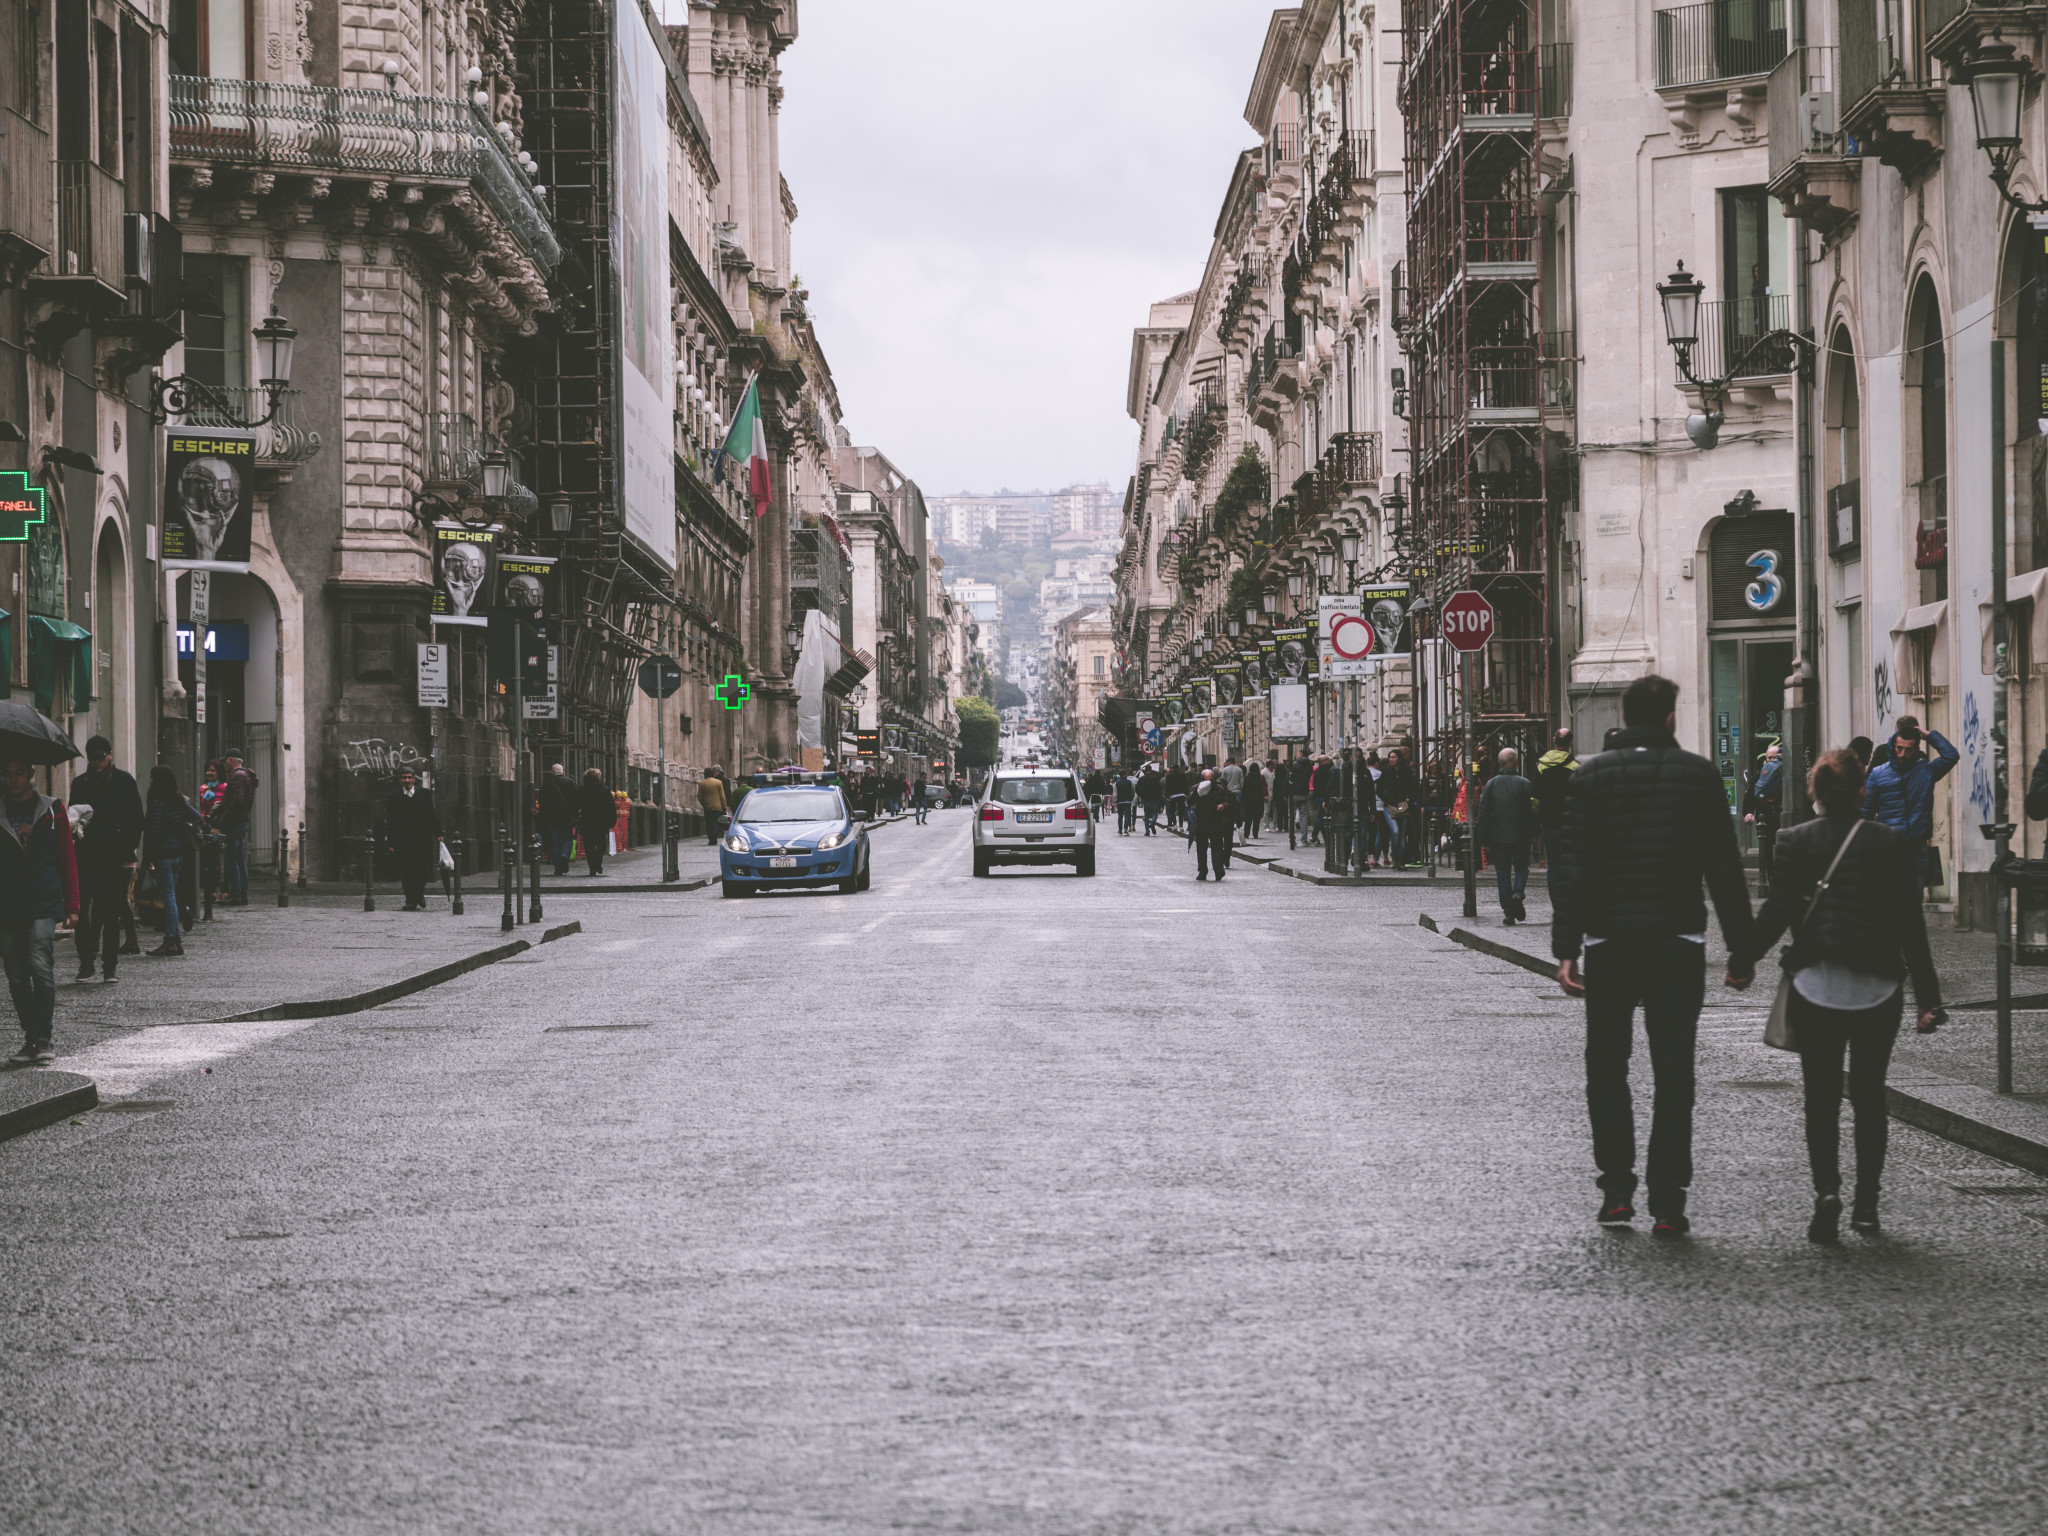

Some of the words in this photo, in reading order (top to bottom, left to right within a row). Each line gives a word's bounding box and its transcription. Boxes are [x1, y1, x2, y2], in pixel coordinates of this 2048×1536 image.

[173, 440, 249, 455] ESCHER
[438, 530, 493, 542] ESCHER
[503, 563, 550, 574] ESCHER
[1744, 549, 1782, 611] 3
[1366, 590, 1407, 599] ESCHER
[1445, 609, 1490, 633] STOP
[1276, 633, 1308, 642] ESCHER
[1145, 743, 1155, 751] 20
